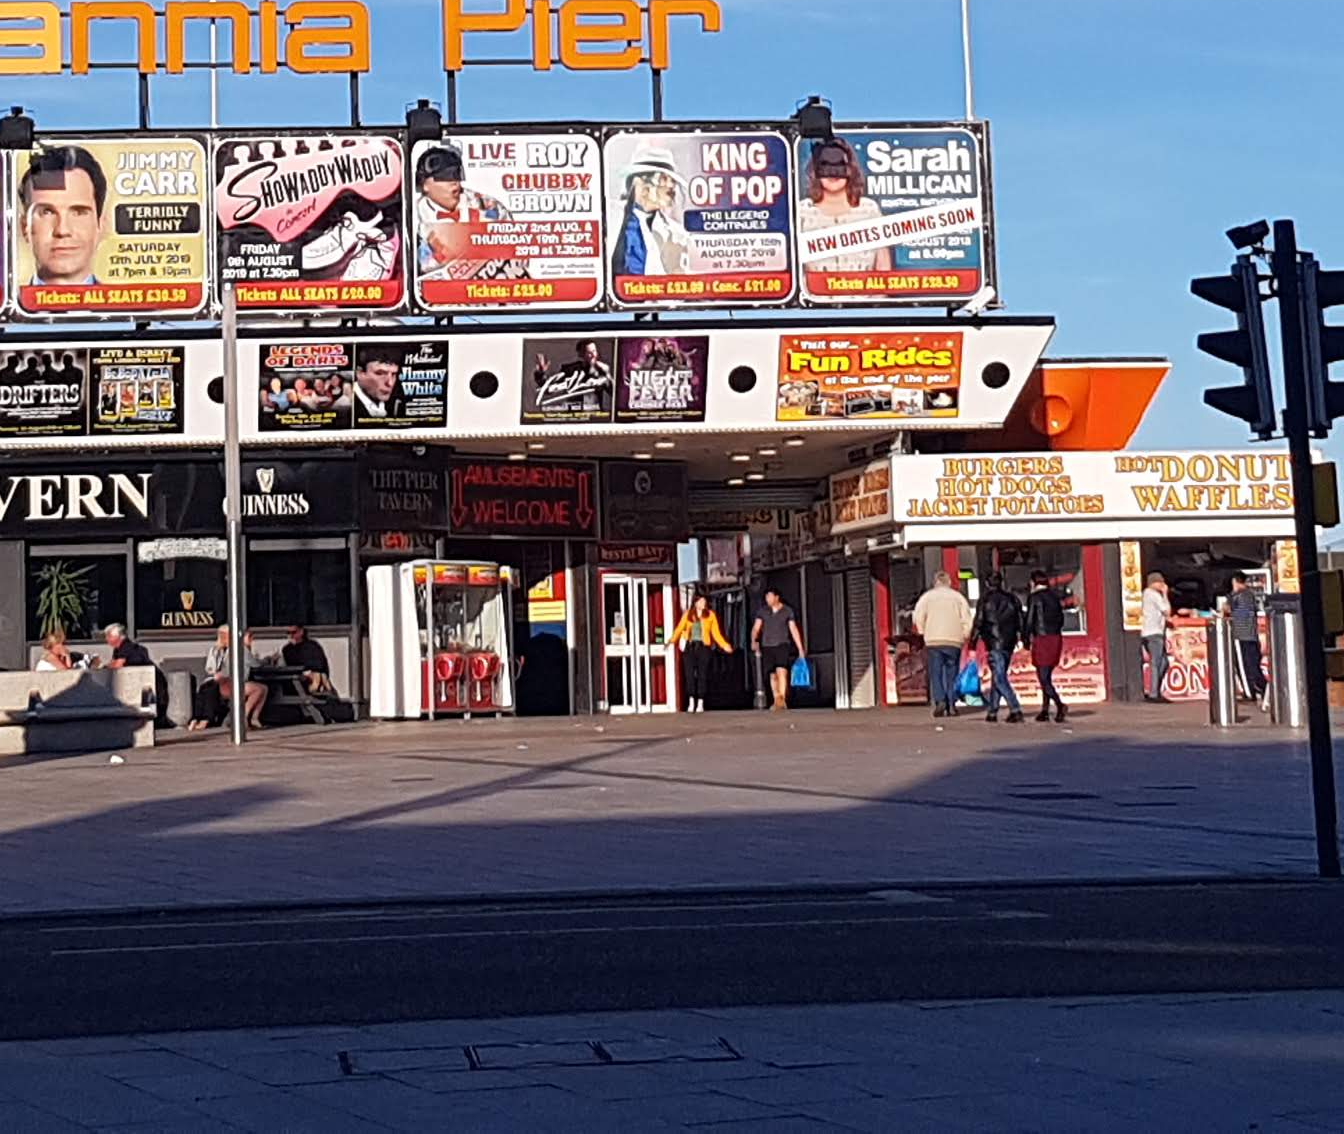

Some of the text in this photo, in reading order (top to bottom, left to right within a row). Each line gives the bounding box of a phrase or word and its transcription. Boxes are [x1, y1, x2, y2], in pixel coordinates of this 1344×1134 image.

[116, 151, 196, 171] JIMMY
[468, 141, 589, 168] LIVE ROY
[701, 142, 767, 172] KING
[867, 140, 970, 173] Sarah
[114, 170, 197, 196] CARR
[501, 172, 592, 191] CHUBBY
[867, 174, 971, 196] MILLICAN
[689, 175, 783, 206] OF POP
[509, 193, 593, 213] BROWN
[126, 206, 189, 218] TERRIBLY
[701, 210, 769, 221] THE LEGEND
[134, 219, 183, 232] FUNNY
[487, 223, 528, 233] FRIDAY
[704, 220, 768, 231] CONTINUES
[807, 207, 976, 254] NEW DATES COMING SOON
[470, 234, 533, 245] THURSDAY
[694, 238, 757, 248] THURSDAY
[118, 243, 182, 254] SATURDAY
[240, 243, 281, 254] FRIDAY
[701, 250, 747, 259] AUGUST
[134, 256, 162, 265] JULY
[247, 255, 294, 266] AUGUST
[866, 277, 886, 289] ALL
[83, 291, 106, 304] ALL
[108, 290, 143, 304] SEATS
[280, 287, 302, 300] ALL
[304, 287, 338, 300] SEATS
[270, 345, 344, 357] LEGENDS
[789, 347, 952, 372] Fun Rides
[265, 354, 350, 367] OF DARTS
[399, 367, 447, 382] Jimmy
[630, 368, 693, 386] NIGHT
[841, 375, 859, 385] the
[863, 374, 884, 384] end
[904, 373, 924, 384] the
[400, 381, 443, 397] White
[629, 384, 694, 401] FEVER
[943, 456, 1064, 478] BURGERS
[1115, 454, 1294, 483] HOT DONUT
[369, 468, 405, 491] THE
[464, 465, 578, 489] AMUSEMENTS
[936, 476, 1073, 497] HOT DOGS
[379, 491, 434, 512] TAVERN
[907, 495, 1105, 517] JACKET POTATOES
[1131, 483, 1296, 512] WAFFLES
[472, 500, 572, 526] WELCOME
[161, 611, 215, 627] GUINNESS
